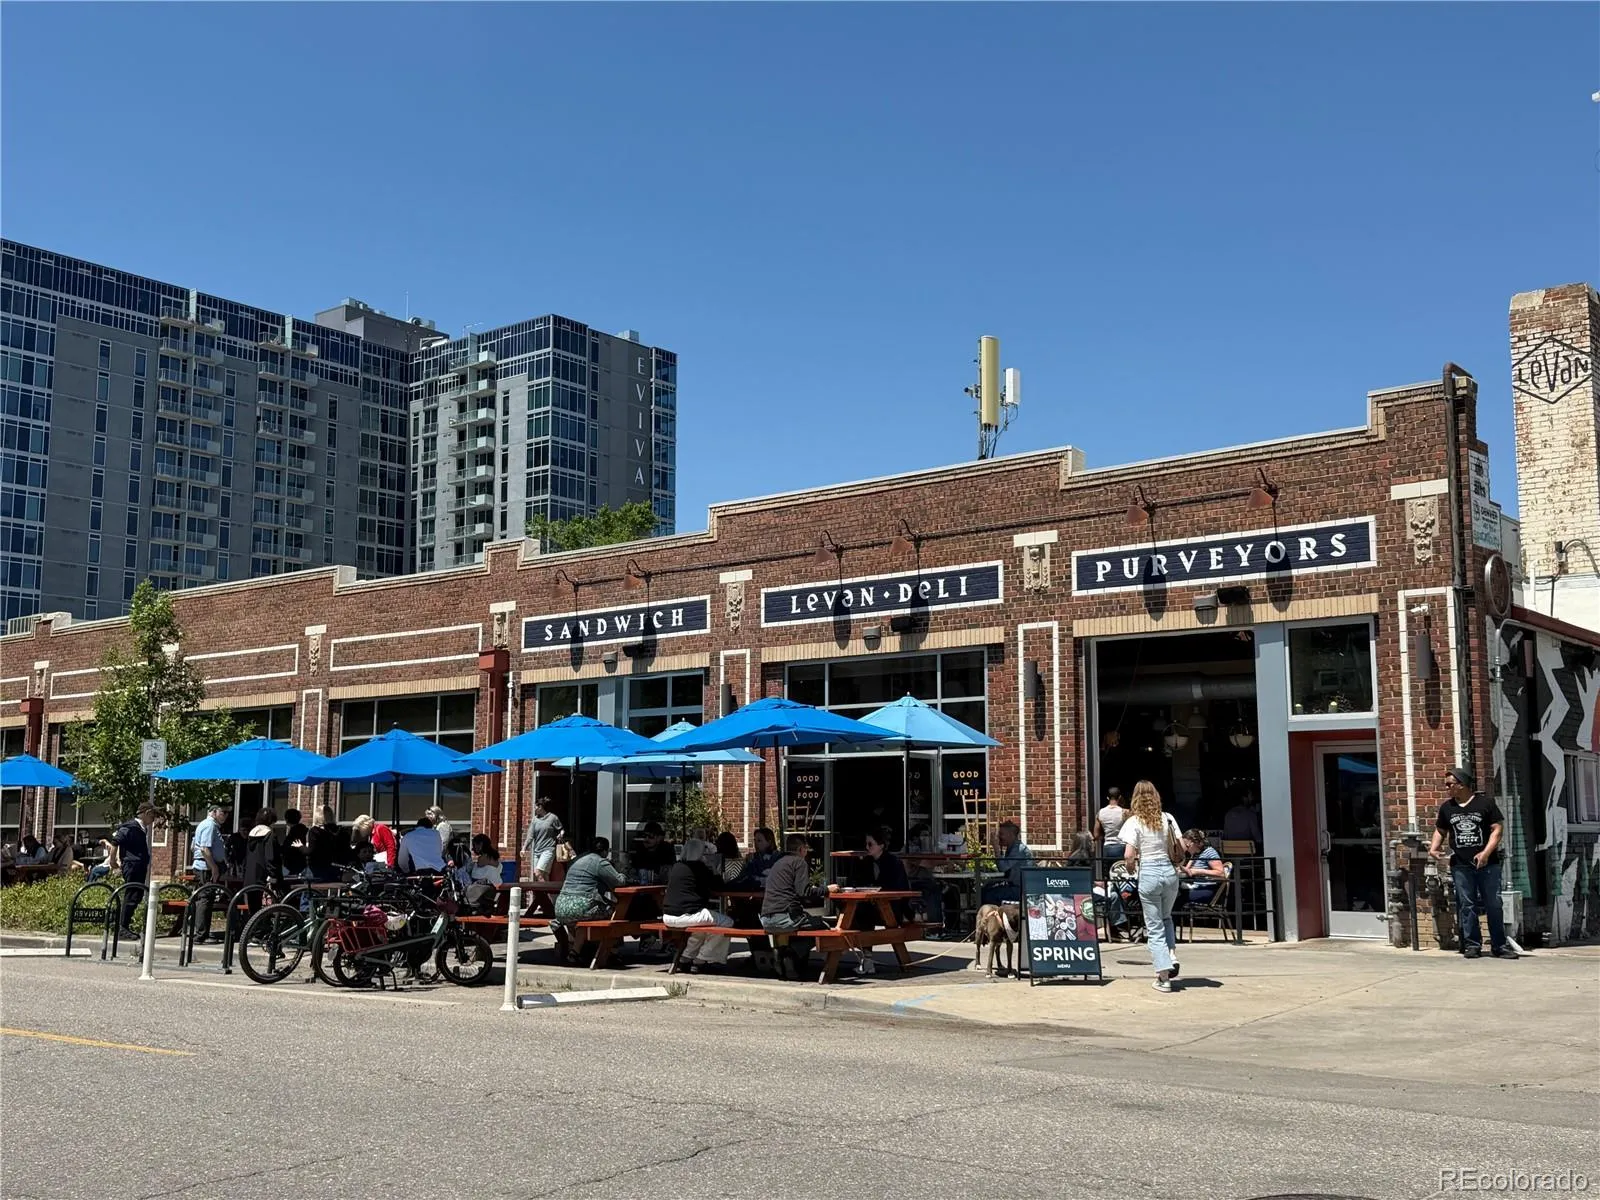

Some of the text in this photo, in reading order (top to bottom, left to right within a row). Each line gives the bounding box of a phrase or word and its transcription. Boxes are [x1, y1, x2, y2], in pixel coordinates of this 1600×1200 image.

[634, 357, 646, 485] EVIVA
[1095, 533, 1347, 583] PURVEYORS
[544, 608, 684, 642] SANDWICH
[797, 775, 820, 783] GOOD
[952, 770, 979, 779] GOOD
[797, 791, 819, 799] FOOD
[954, 788, 980, 796] VIBES
[1033, 946, 1096, 961] SPRING
